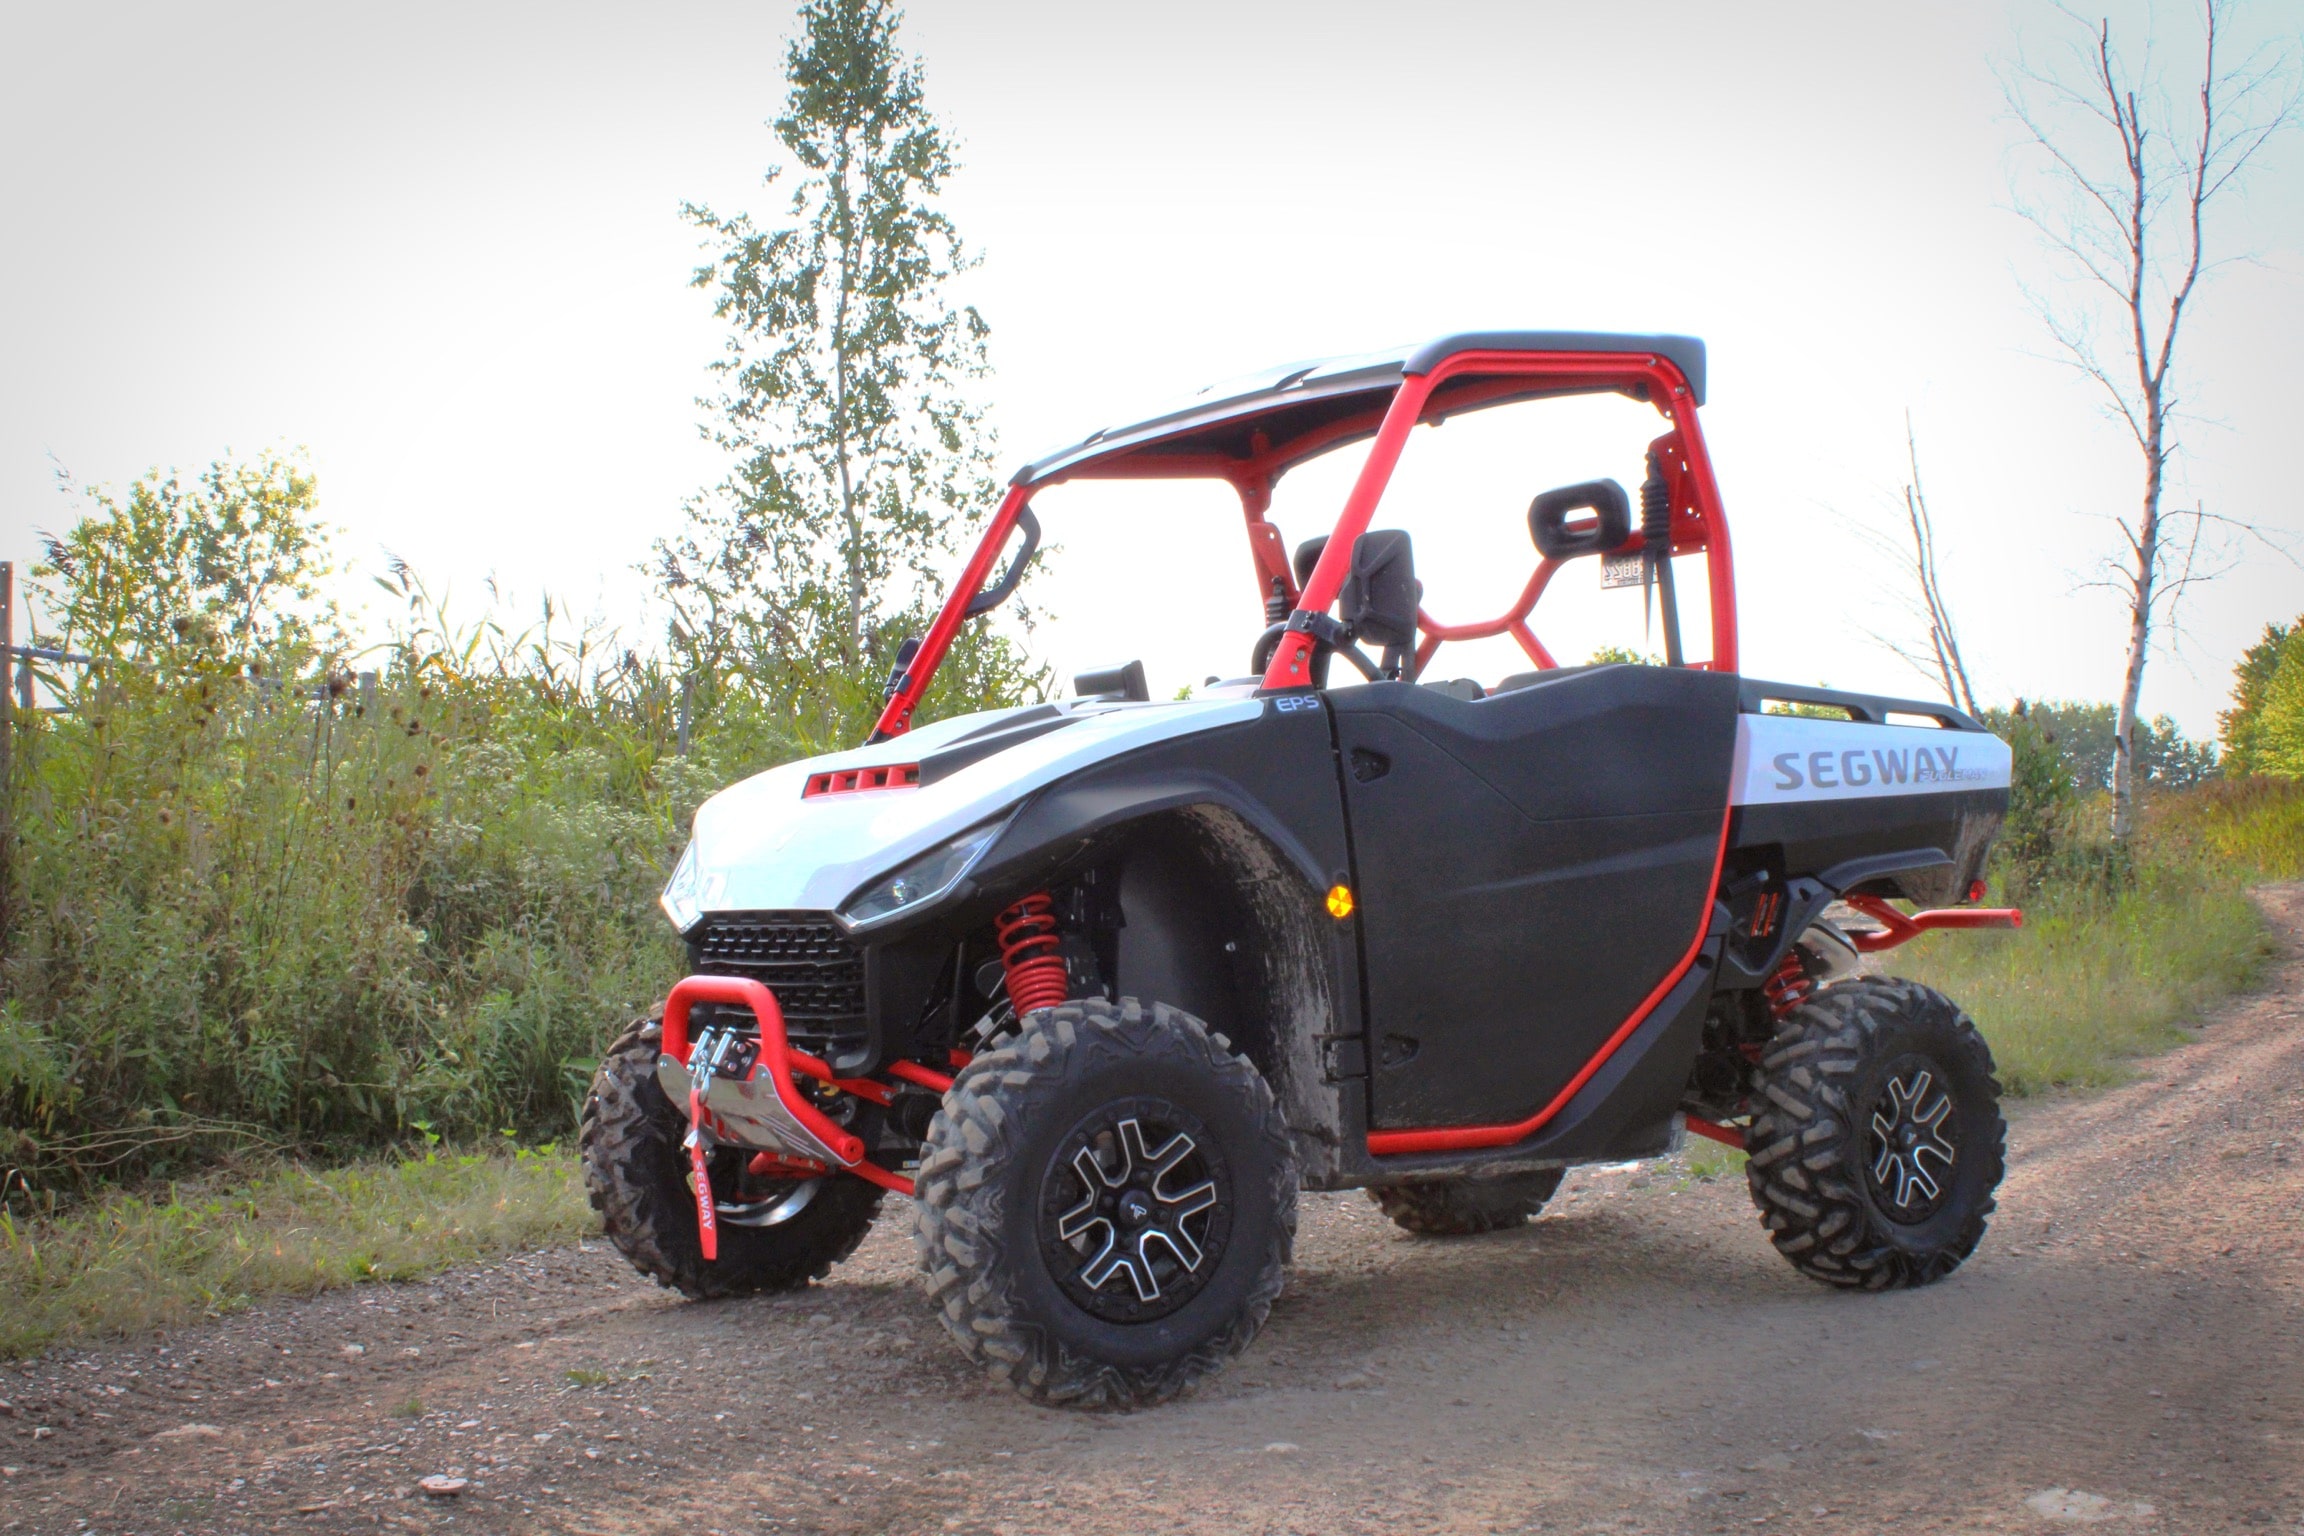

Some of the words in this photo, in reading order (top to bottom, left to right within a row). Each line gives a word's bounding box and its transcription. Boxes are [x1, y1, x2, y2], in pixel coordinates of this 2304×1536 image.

[1275, 695, 1319, 712] EPS
[1772, 746, 1958, 791] SEGWAY
[695, 1160, 713, 1230] SEGWAY
